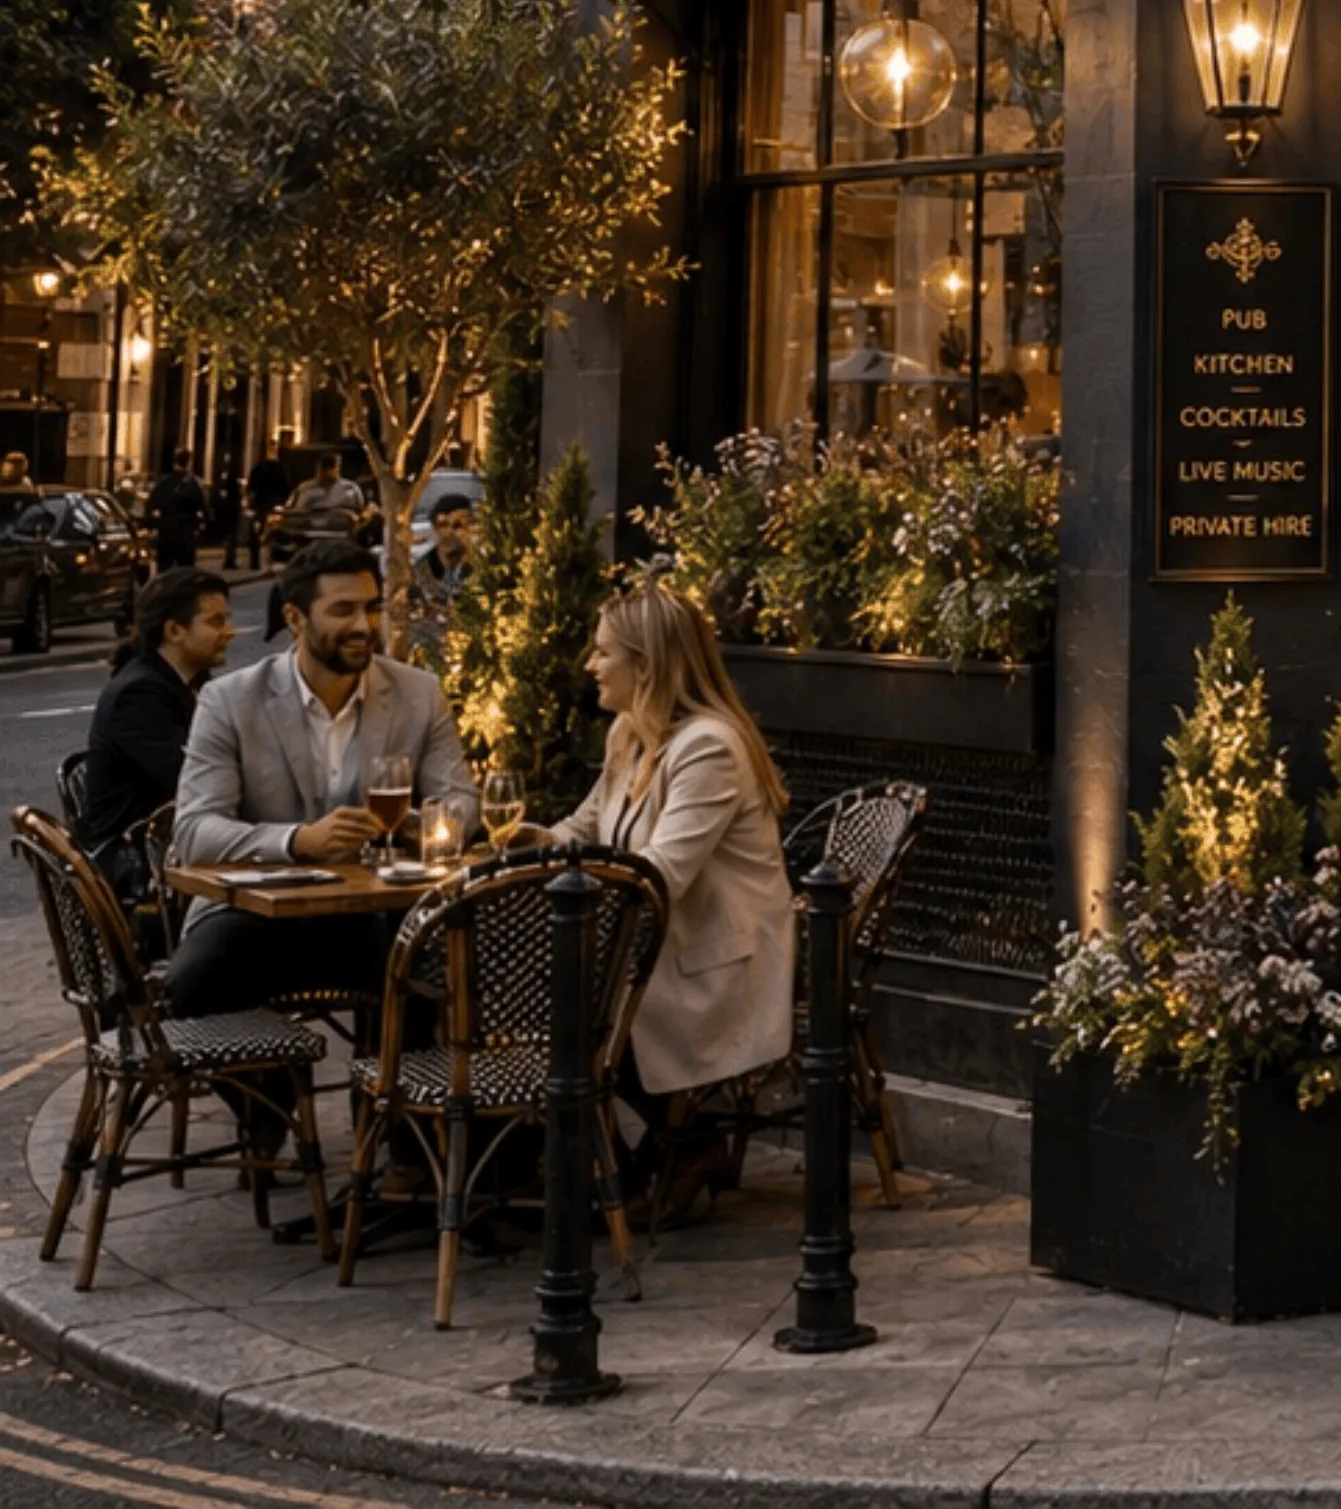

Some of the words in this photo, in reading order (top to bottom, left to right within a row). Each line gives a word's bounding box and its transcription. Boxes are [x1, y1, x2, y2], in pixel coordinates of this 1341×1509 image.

[1221, 308, 1268, 330] PUB
[1194, 353, 1294, 375] KITCHEN
[1179, 406, 1307, 428] COCKTAILS
[1178, 460, 1226, 482] LIVE
[1232, 460, 1306, 482] MUSIC
[1169, 515, 1257, 537] PRIVATE
[1263, 515, 1312, 537] HIRE
